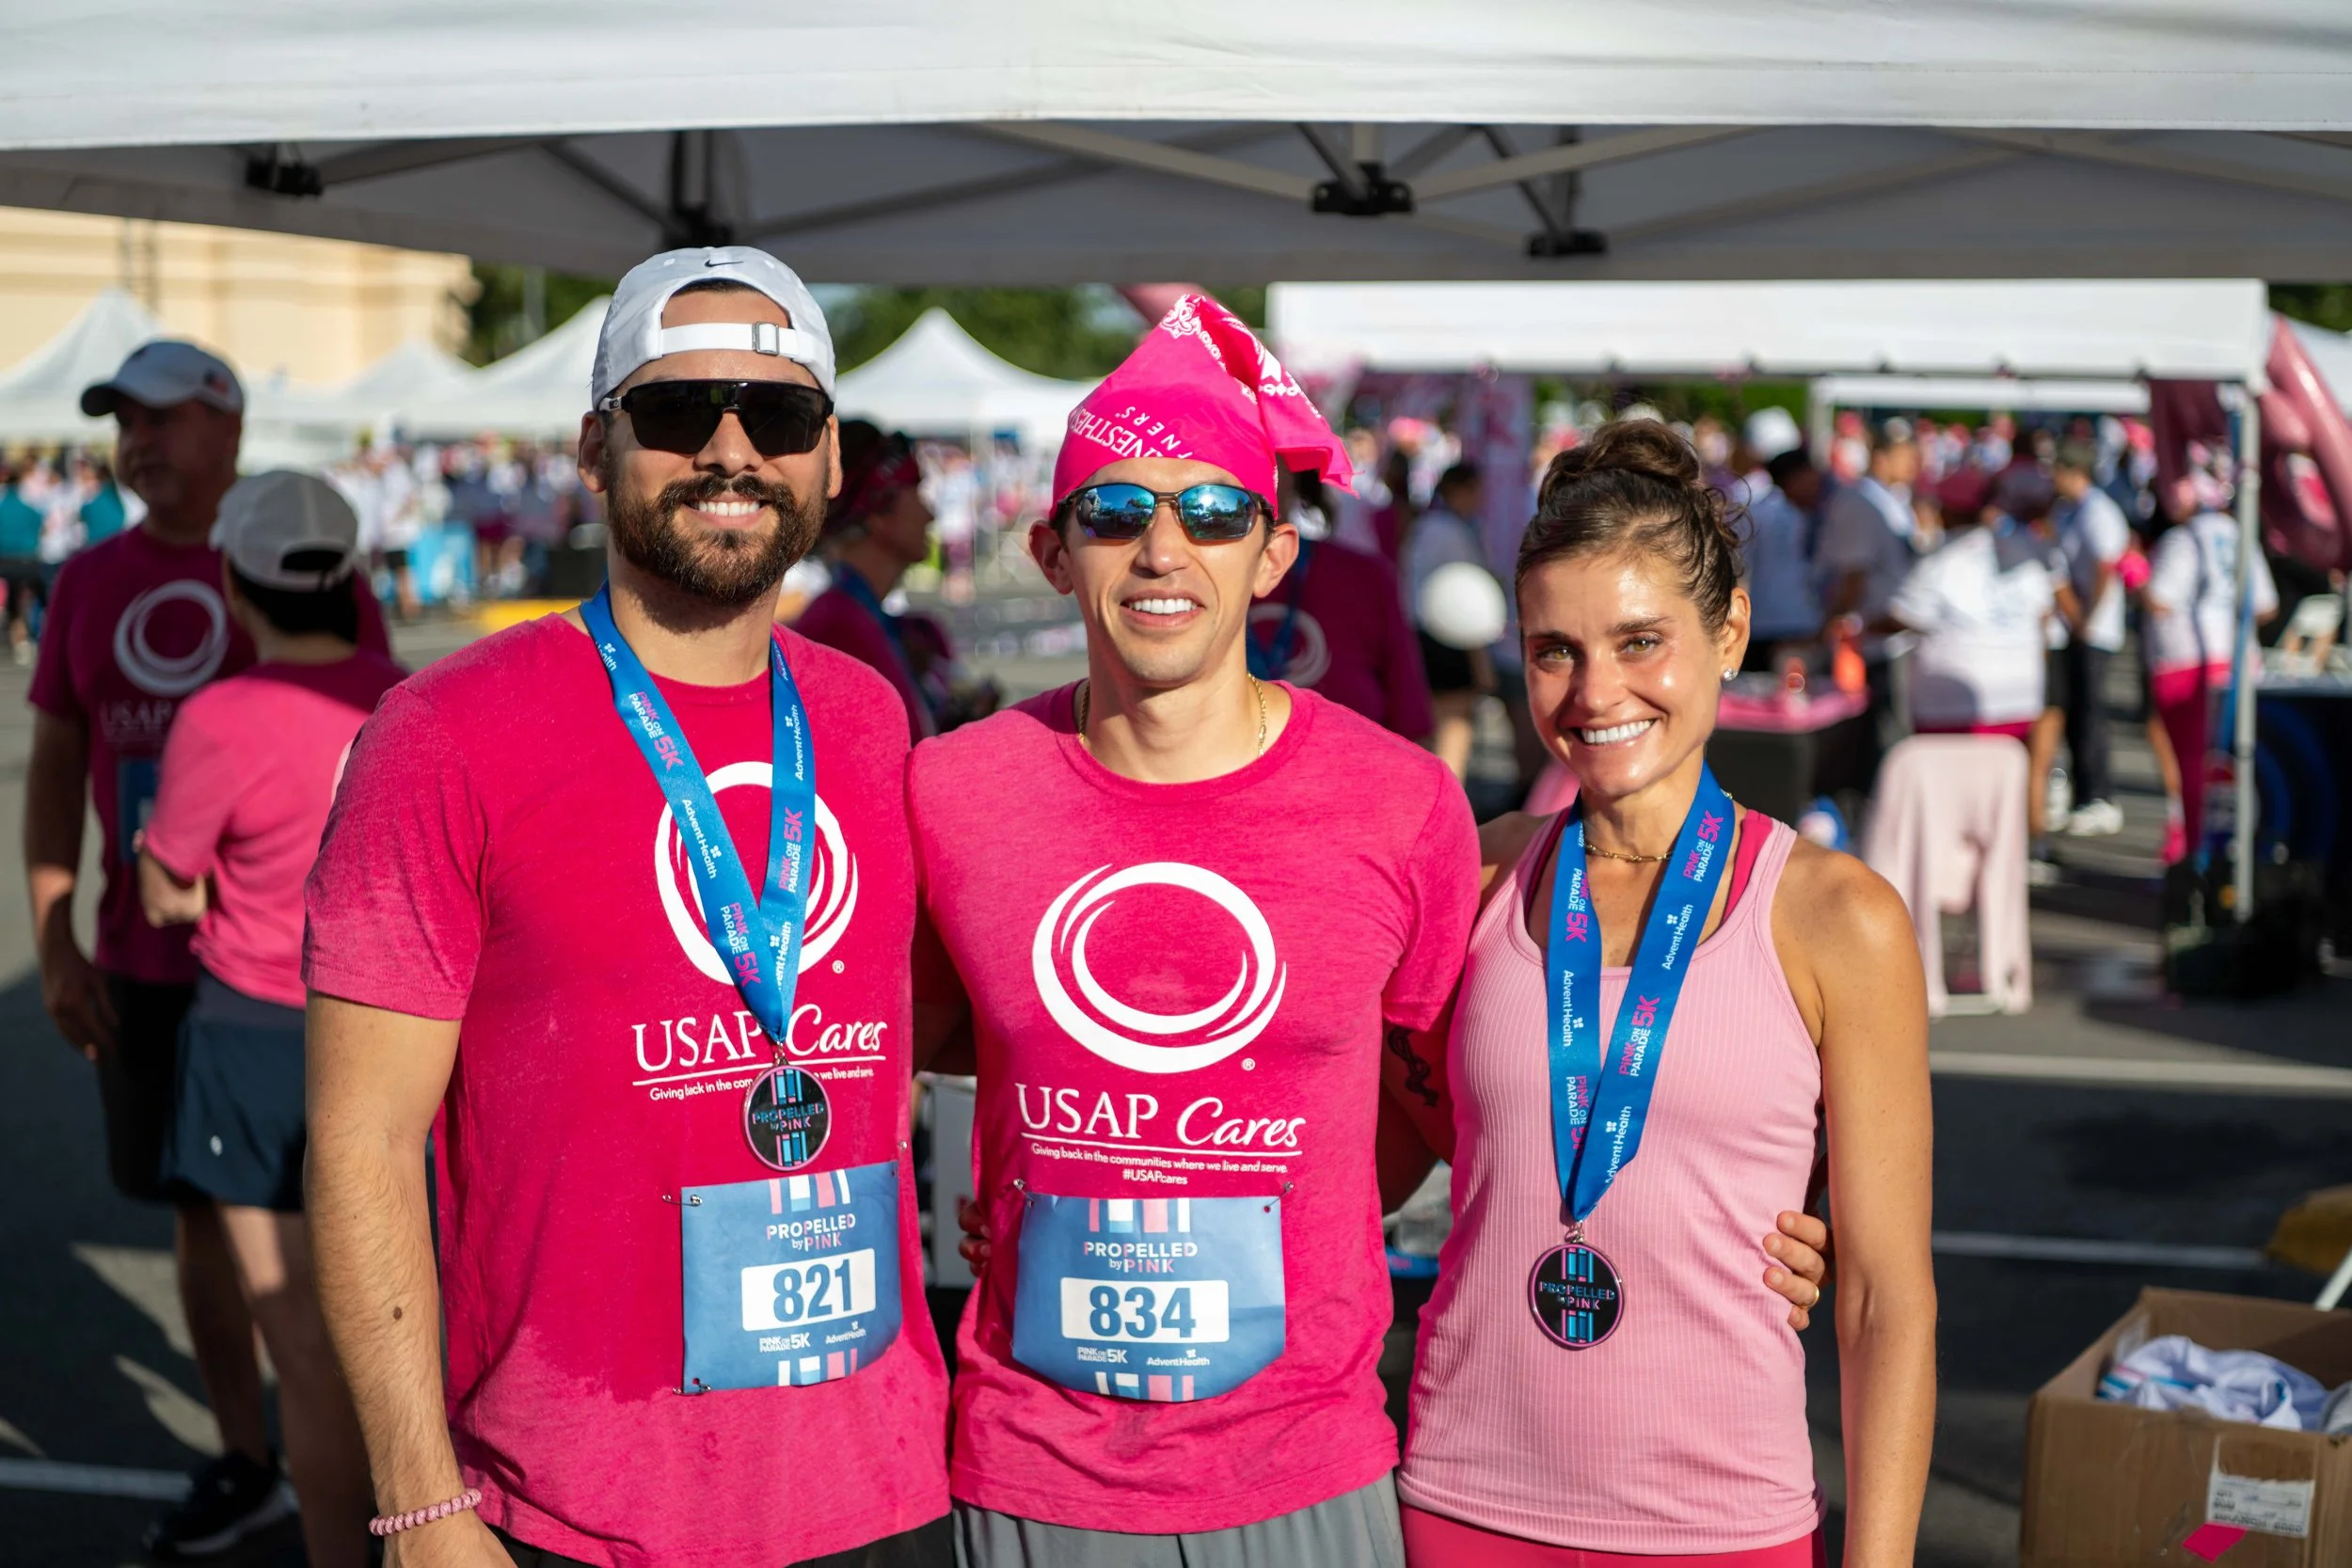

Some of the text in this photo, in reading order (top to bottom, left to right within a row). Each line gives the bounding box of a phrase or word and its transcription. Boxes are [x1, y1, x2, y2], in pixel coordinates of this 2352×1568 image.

[628, 692, 684, 772] PARADE 5K
[636, 691, 665, 736] PINK ON
[791, 705, 803, 782] AdventHealth
[682, 799, 718, 879] AdventHealth
[784, 806, 803, 894] PARADE 5K
[1682, 839, 1707, 879] PINK ON
[1693, 810, 1724, 882] PARADE 5K
[778, 841, 793, 891] PINK ON
[1568, 867, 1582, 911] PARADE
[1579, 898, 1585, 911] ON
[721, 905, 761, 988] PARADE 5K
[729, 902, 750, 952] PINK ON
[1565, 911, 1588, 942] 5K
[1661, 903, 1693, 971] AdventHealth
[1563, 970, 1574, 1047] AdventHealth
[631, 1004, 887, 1071] USAP Cares
[1618, 1027, 1642, 1075] PINK ON
[1629, 994, 1661, 1077] PARADE 5K
[649, 1087, 684, 1101] Giving
[706, 1083, 715, 1093] in
[716, 1079, 732, 1091] the
[819, 1070, 833, 1080] we
[1565, 1076, 1580, 1125] PARADE
[1576, 1075, 1589, 1124] PINK ON
[753, 1102, 824, 1124] PROPELLED
[780, 1116, 811, 1132] PINK
[1014, 1083, 1306, 1148] USAP Cares
[1031, 1143, 1059, 1159] Giving
[1061, 1147, 1083, 1160] back
[1085, 1150, 1093, 1161] in
[1093, 1150, 1108, 1163] the
[1109, 1156, 1172, 1168] communities
[1174, 1157, 1204, 1170] where
[1206, 1163, 1221, 1171] we
[1222, 1160, 1240, 1172] live
[1240, 1161, 1261, 1173] and
[1122, 1168, 1188, 1185] #USAPcares
[767, 1213, 856, 1241] PROPELLED
[792, 1232, 842, 1252] by PINK
[1084, 1242, 1198, 1258] PROPELLED
[1109, 1259, 1174, 1274] by PINK
[773, 1259, 852, 1323] 821
[1089, 1285, 1197, 1338] 834
[1538, 1281, 1615, 1300] PROPELLED
[1566, 1296, 1599, 1310] PINK
[790, 1332, 811, 1350] 5K
[825, 1327, 866, 1344] AdventHealth
[1076, 1346, 1098, 1355] PINK
[1077, 1348, 1128, 1364] PARADE 5K
[1146, 1356, 1210, 1367] AdventHealth
